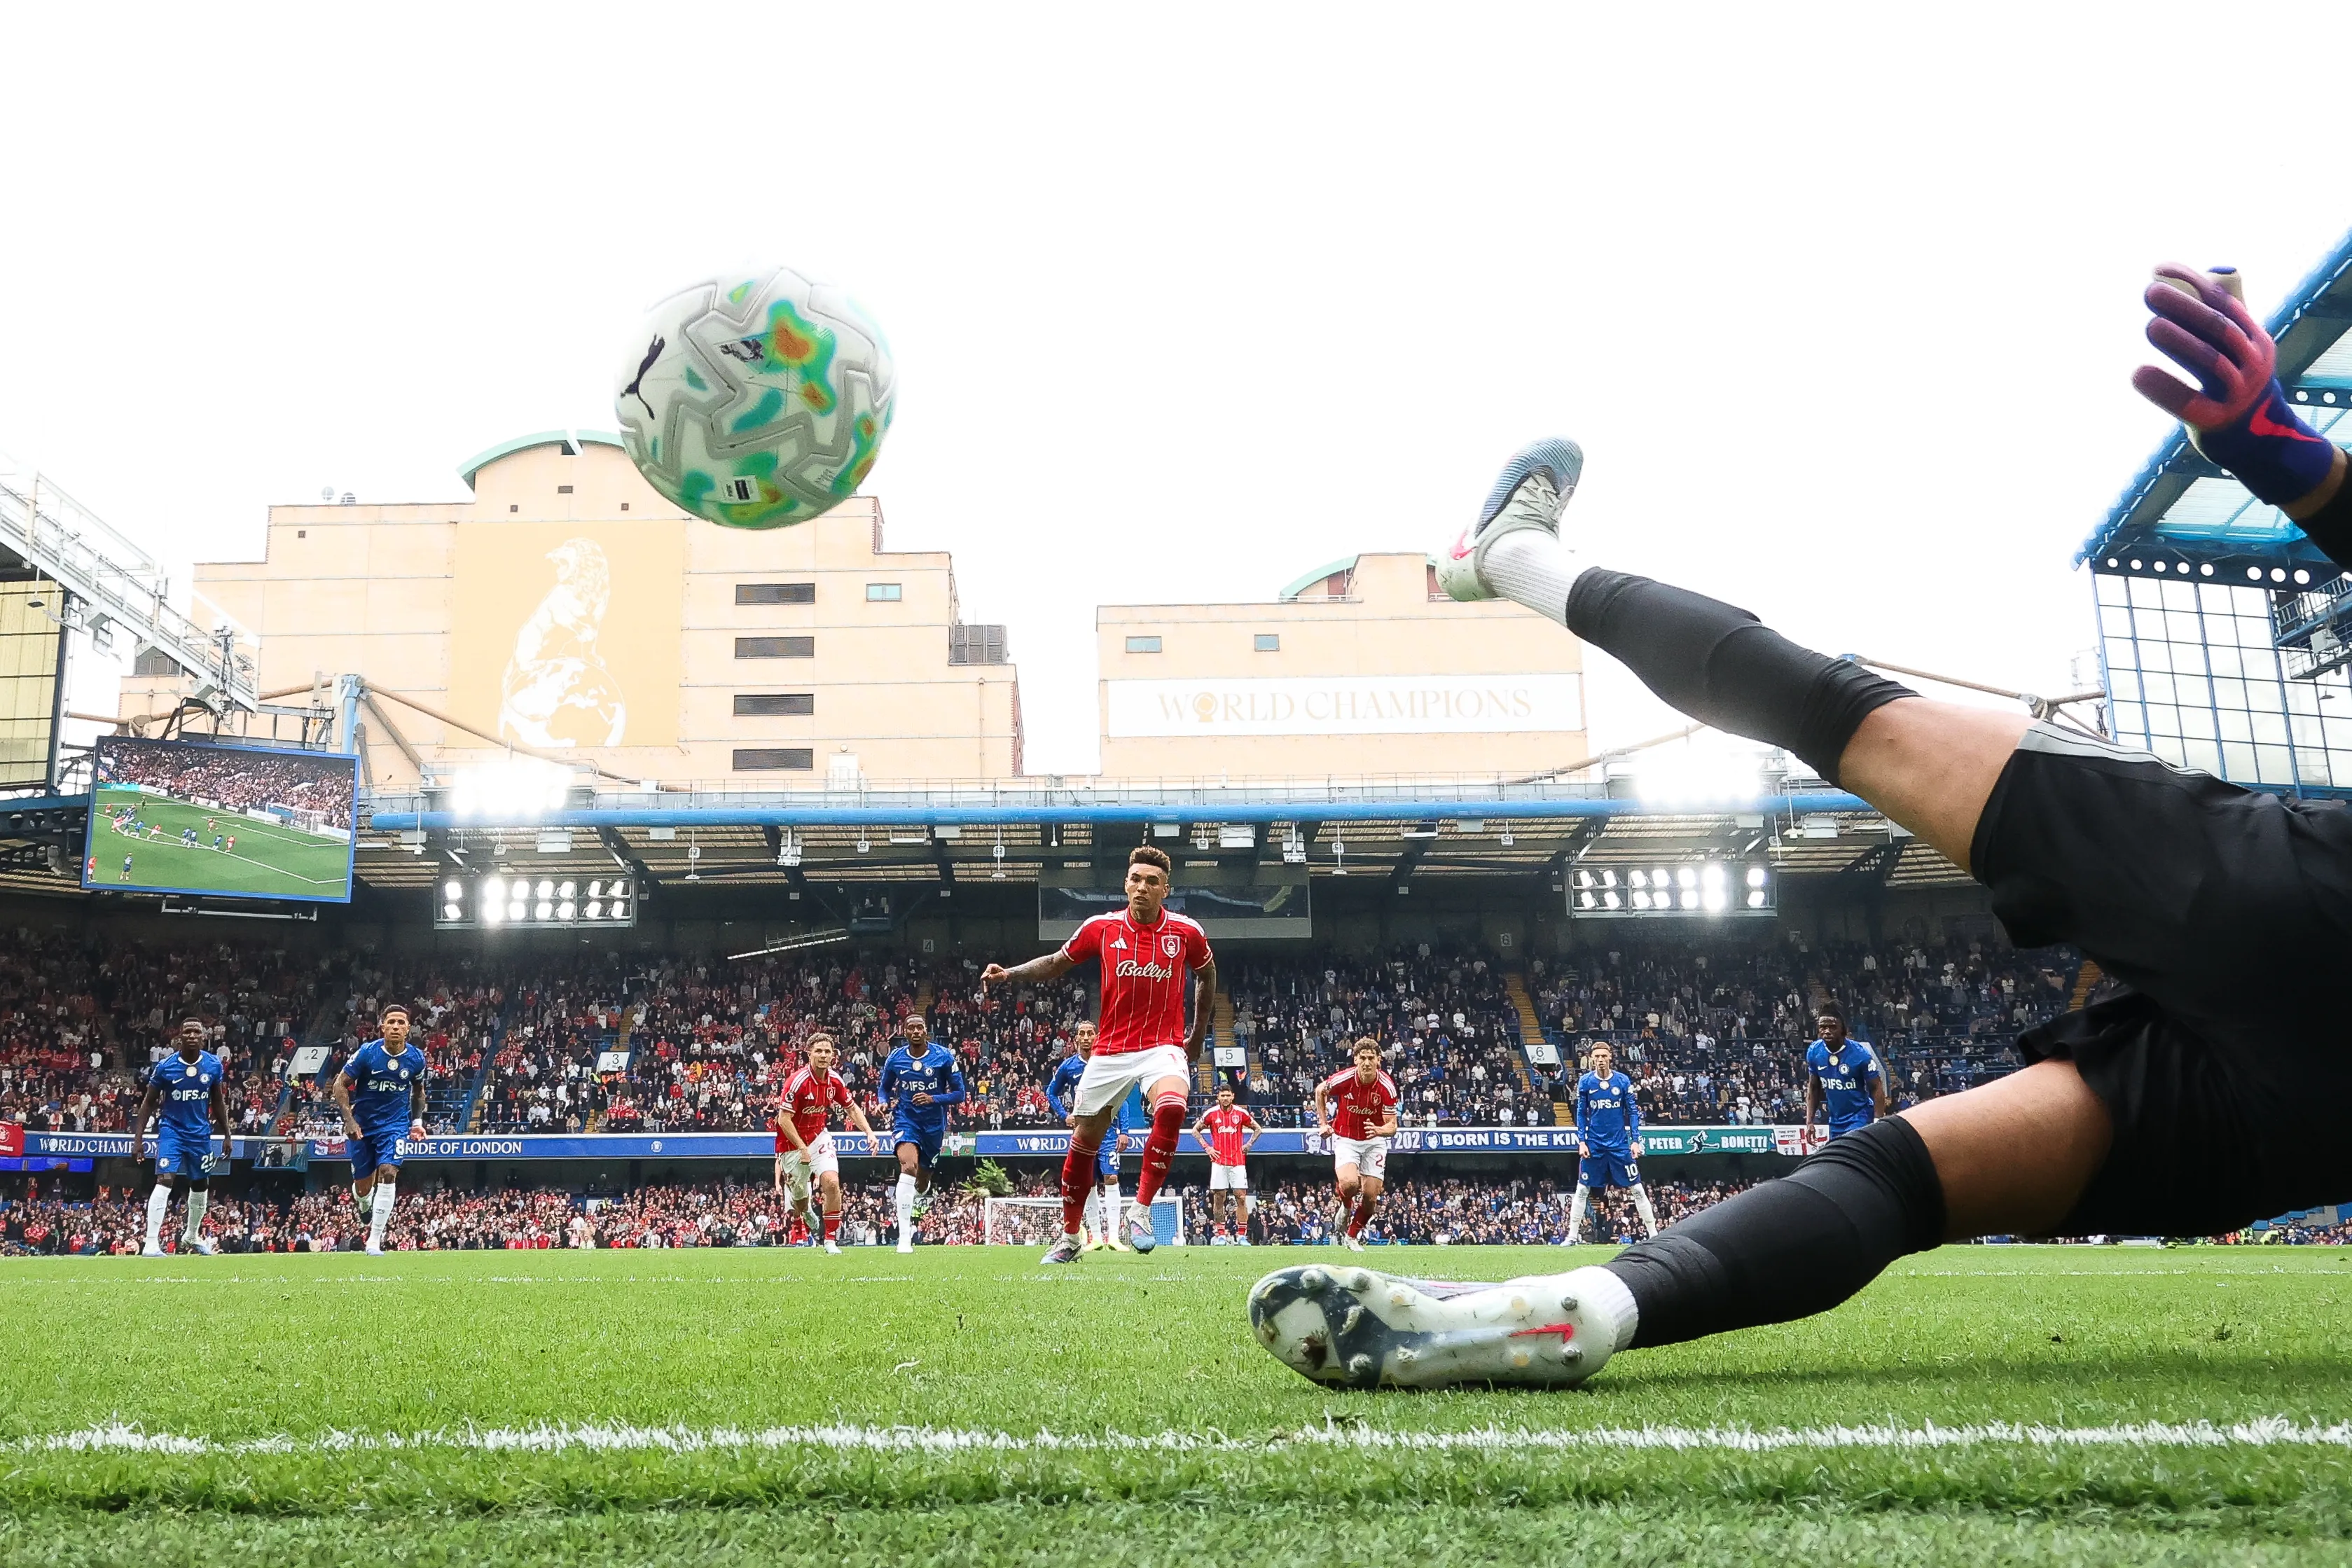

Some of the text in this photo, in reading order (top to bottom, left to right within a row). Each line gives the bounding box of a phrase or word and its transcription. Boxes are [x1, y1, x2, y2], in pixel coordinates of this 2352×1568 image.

[1304, 688, 1533, 721] CHAMPIONS
[925, 940, 932, 951] 4
[1116, 959, 1172, 982] Bally's
[310, 1048, 318, 1060] 2
[1225, 1049, 1233, 1060] 5
[1536, 1046, 1544, 1057] 6
[612, 1053, 619, 1064] 3
[1597, 1098, 1621, 1109] IFS.ai
[1016, 1137, 1067, 1151] WORLD
[1442, 1132, 1580, 1146] BORN IS THE KIN
[1648, 1137, 1682, 1150] PETER
[1720, 1135, 1767, 1149] BONETTI
[396, 1139, 404, 1155] 8
[405, 1142, 522, 1155] RIDE OF LONDON
[1625, 1163, 1639, 1178] 10
